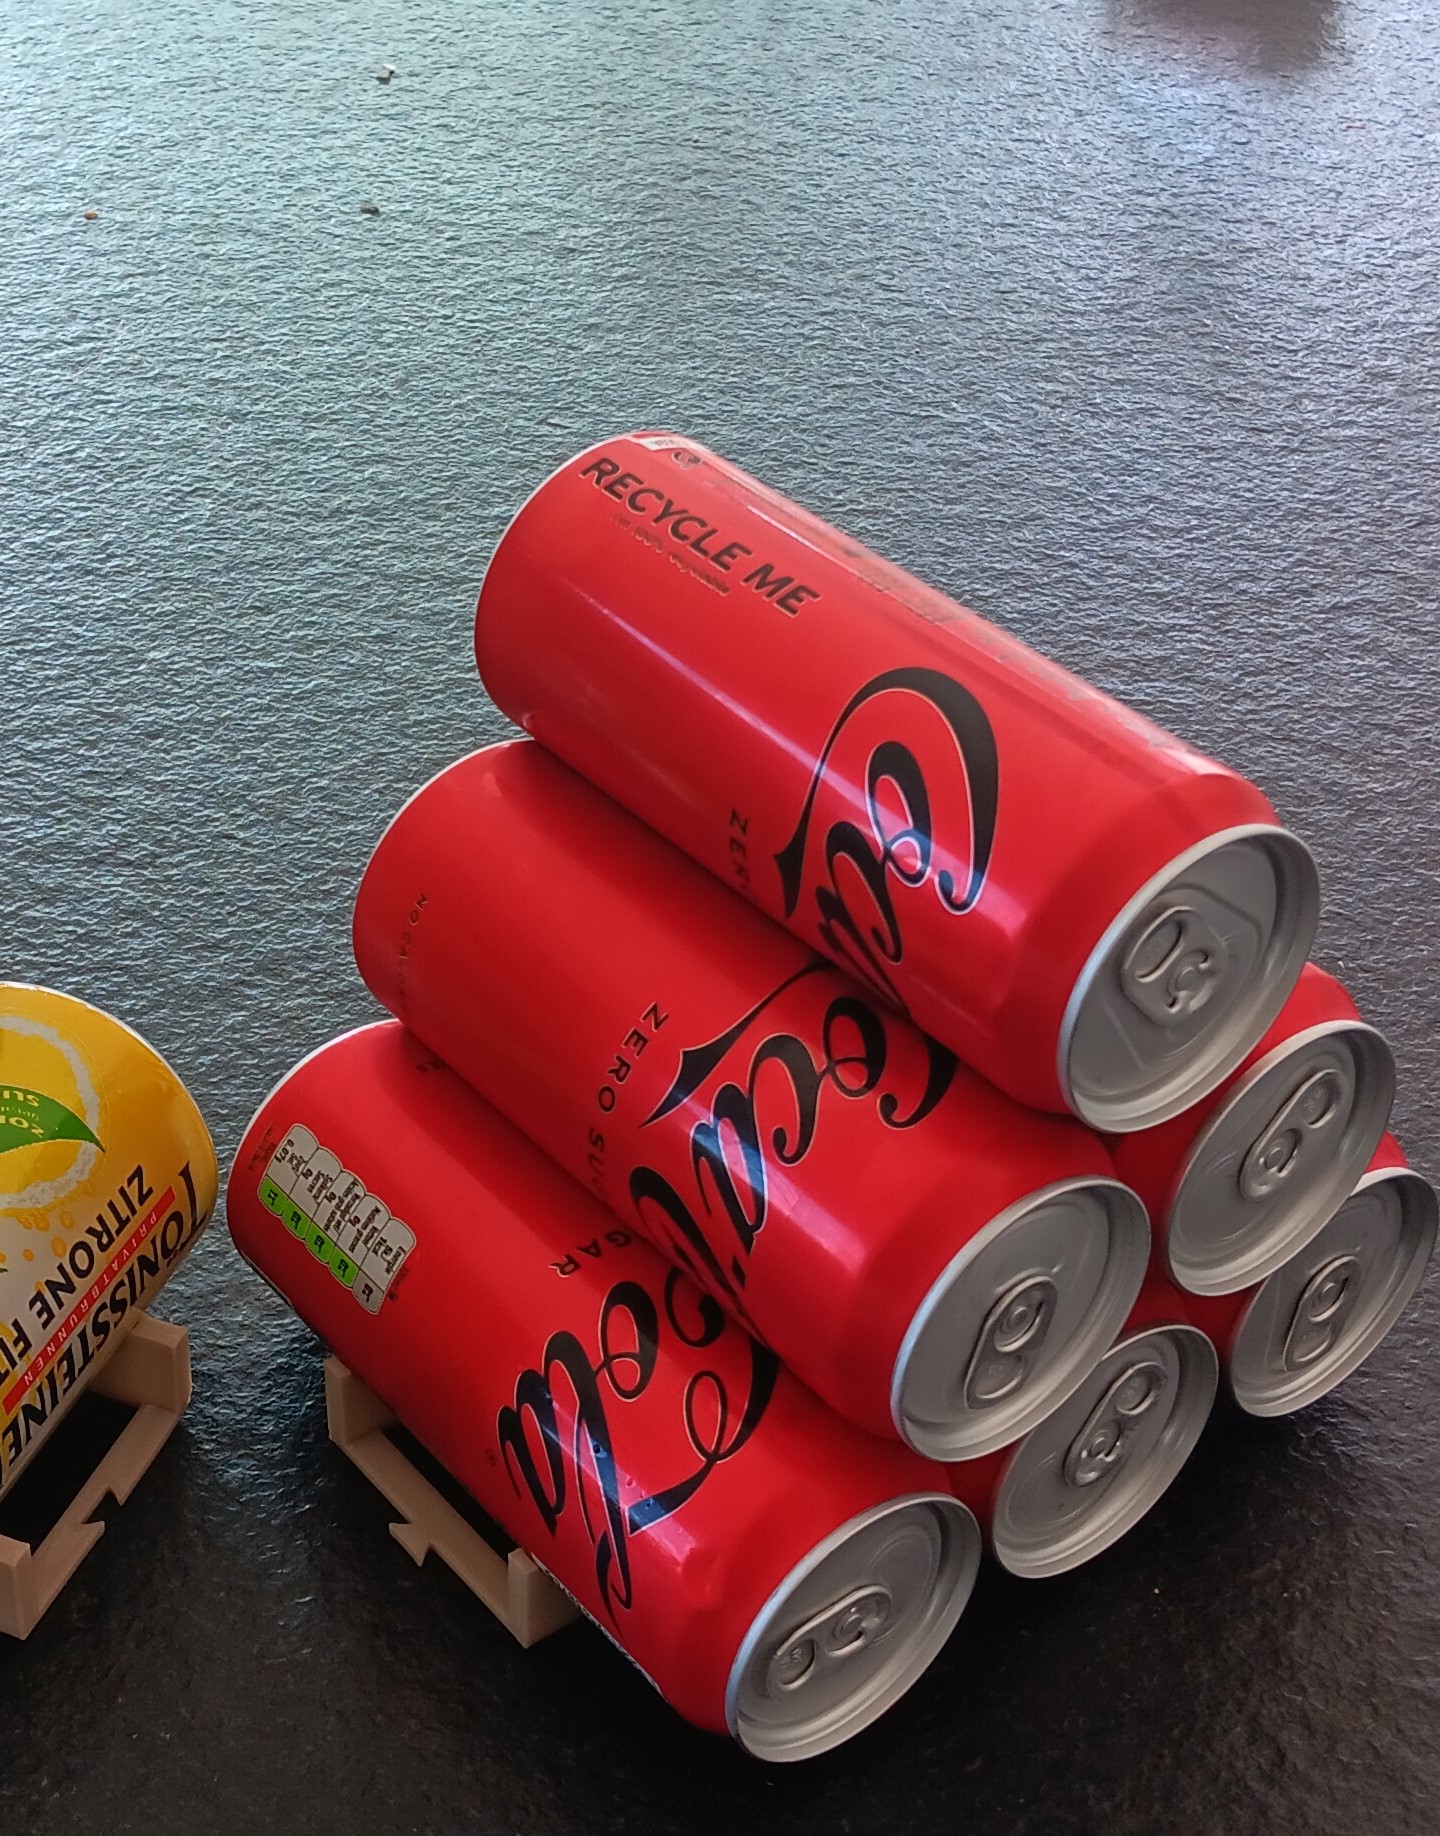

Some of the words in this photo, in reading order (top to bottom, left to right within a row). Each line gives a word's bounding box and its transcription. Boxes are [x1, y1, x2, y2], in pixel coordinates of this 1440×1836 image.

[578, 449, 753, 579] RECYCLE
[739, 554, 822, 624] ME
[596, 999, 671, 1114] ZERO
[18, 1208, 161, 1388] PRIVATBRUNNEN
[23, 1163, 154, 1332] ZITRONE
